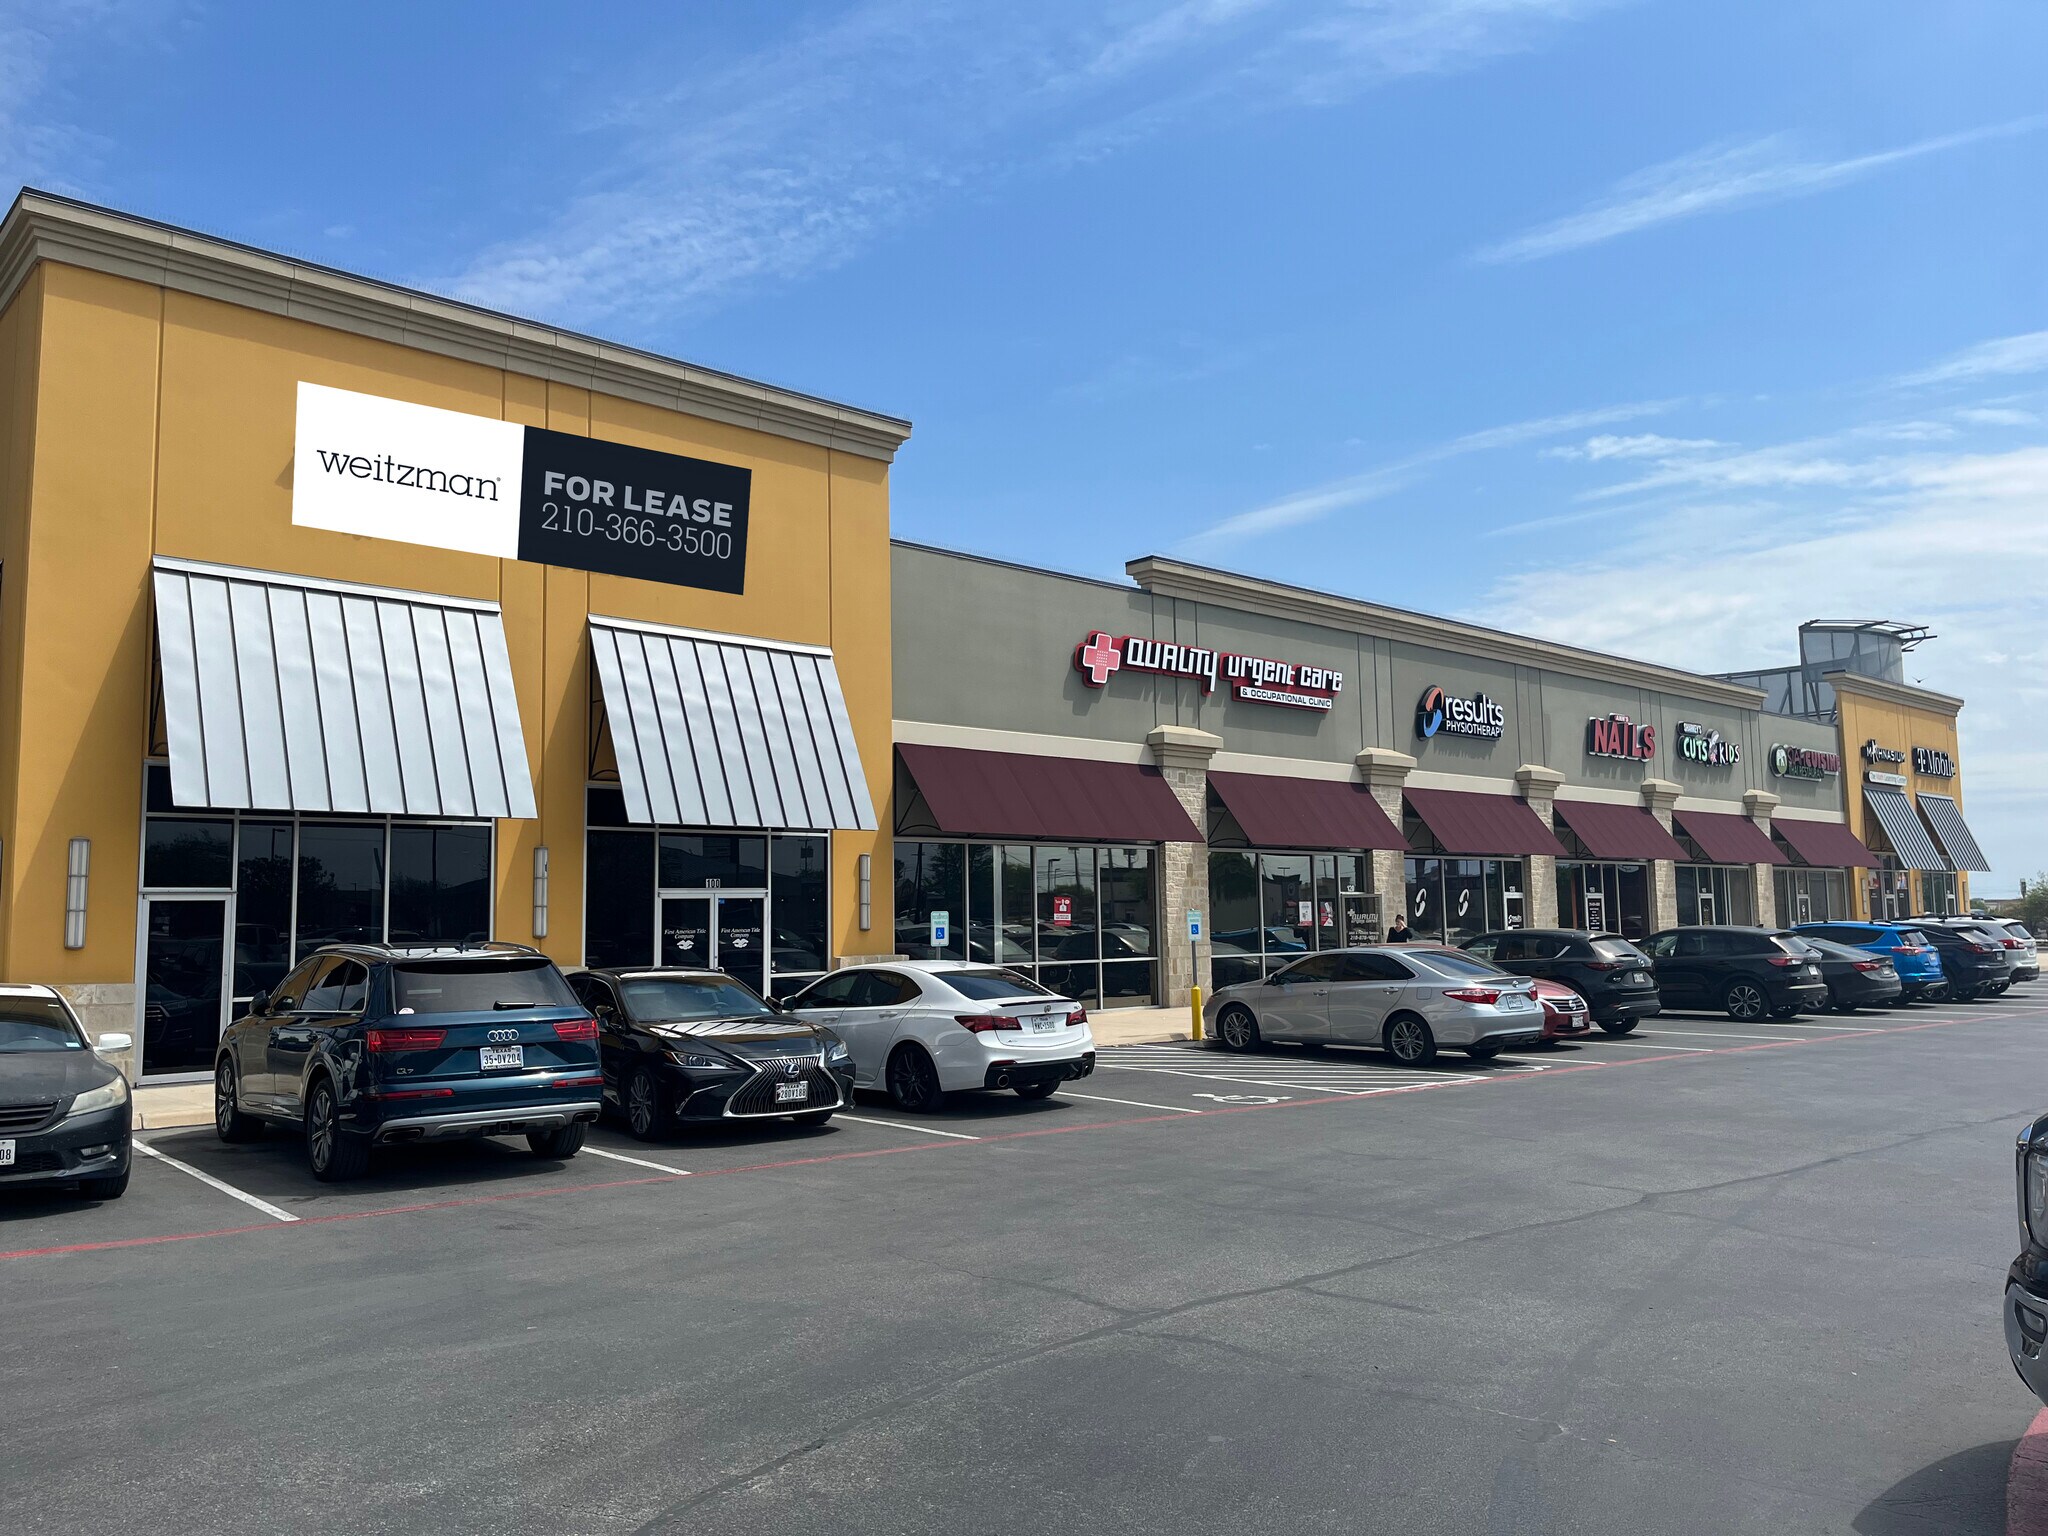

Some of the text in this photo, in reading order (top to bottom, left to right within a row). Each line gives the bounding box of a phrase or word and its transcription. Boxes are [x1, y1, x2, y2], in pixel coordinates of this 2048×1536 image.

[317, 449, 498, 502] weitzman
[544, 470, 733, 528] FOR LEASE
[541, 501, 732, 560] 210-366-3500
[1242, 688, 1331, 708] & OCCUPATIONAL CLINIC
[1445, 694, 1504, 726] results
[1446, 720, 1504, 738] PHYSIOTHERAPY
[1594, 719, 1655, 760] NAILS
[1683, 736, 1740, 764] CUTS KIDS
[706, 879, 720, 888] 100
[396, 1067, 414, 1075] Q7
